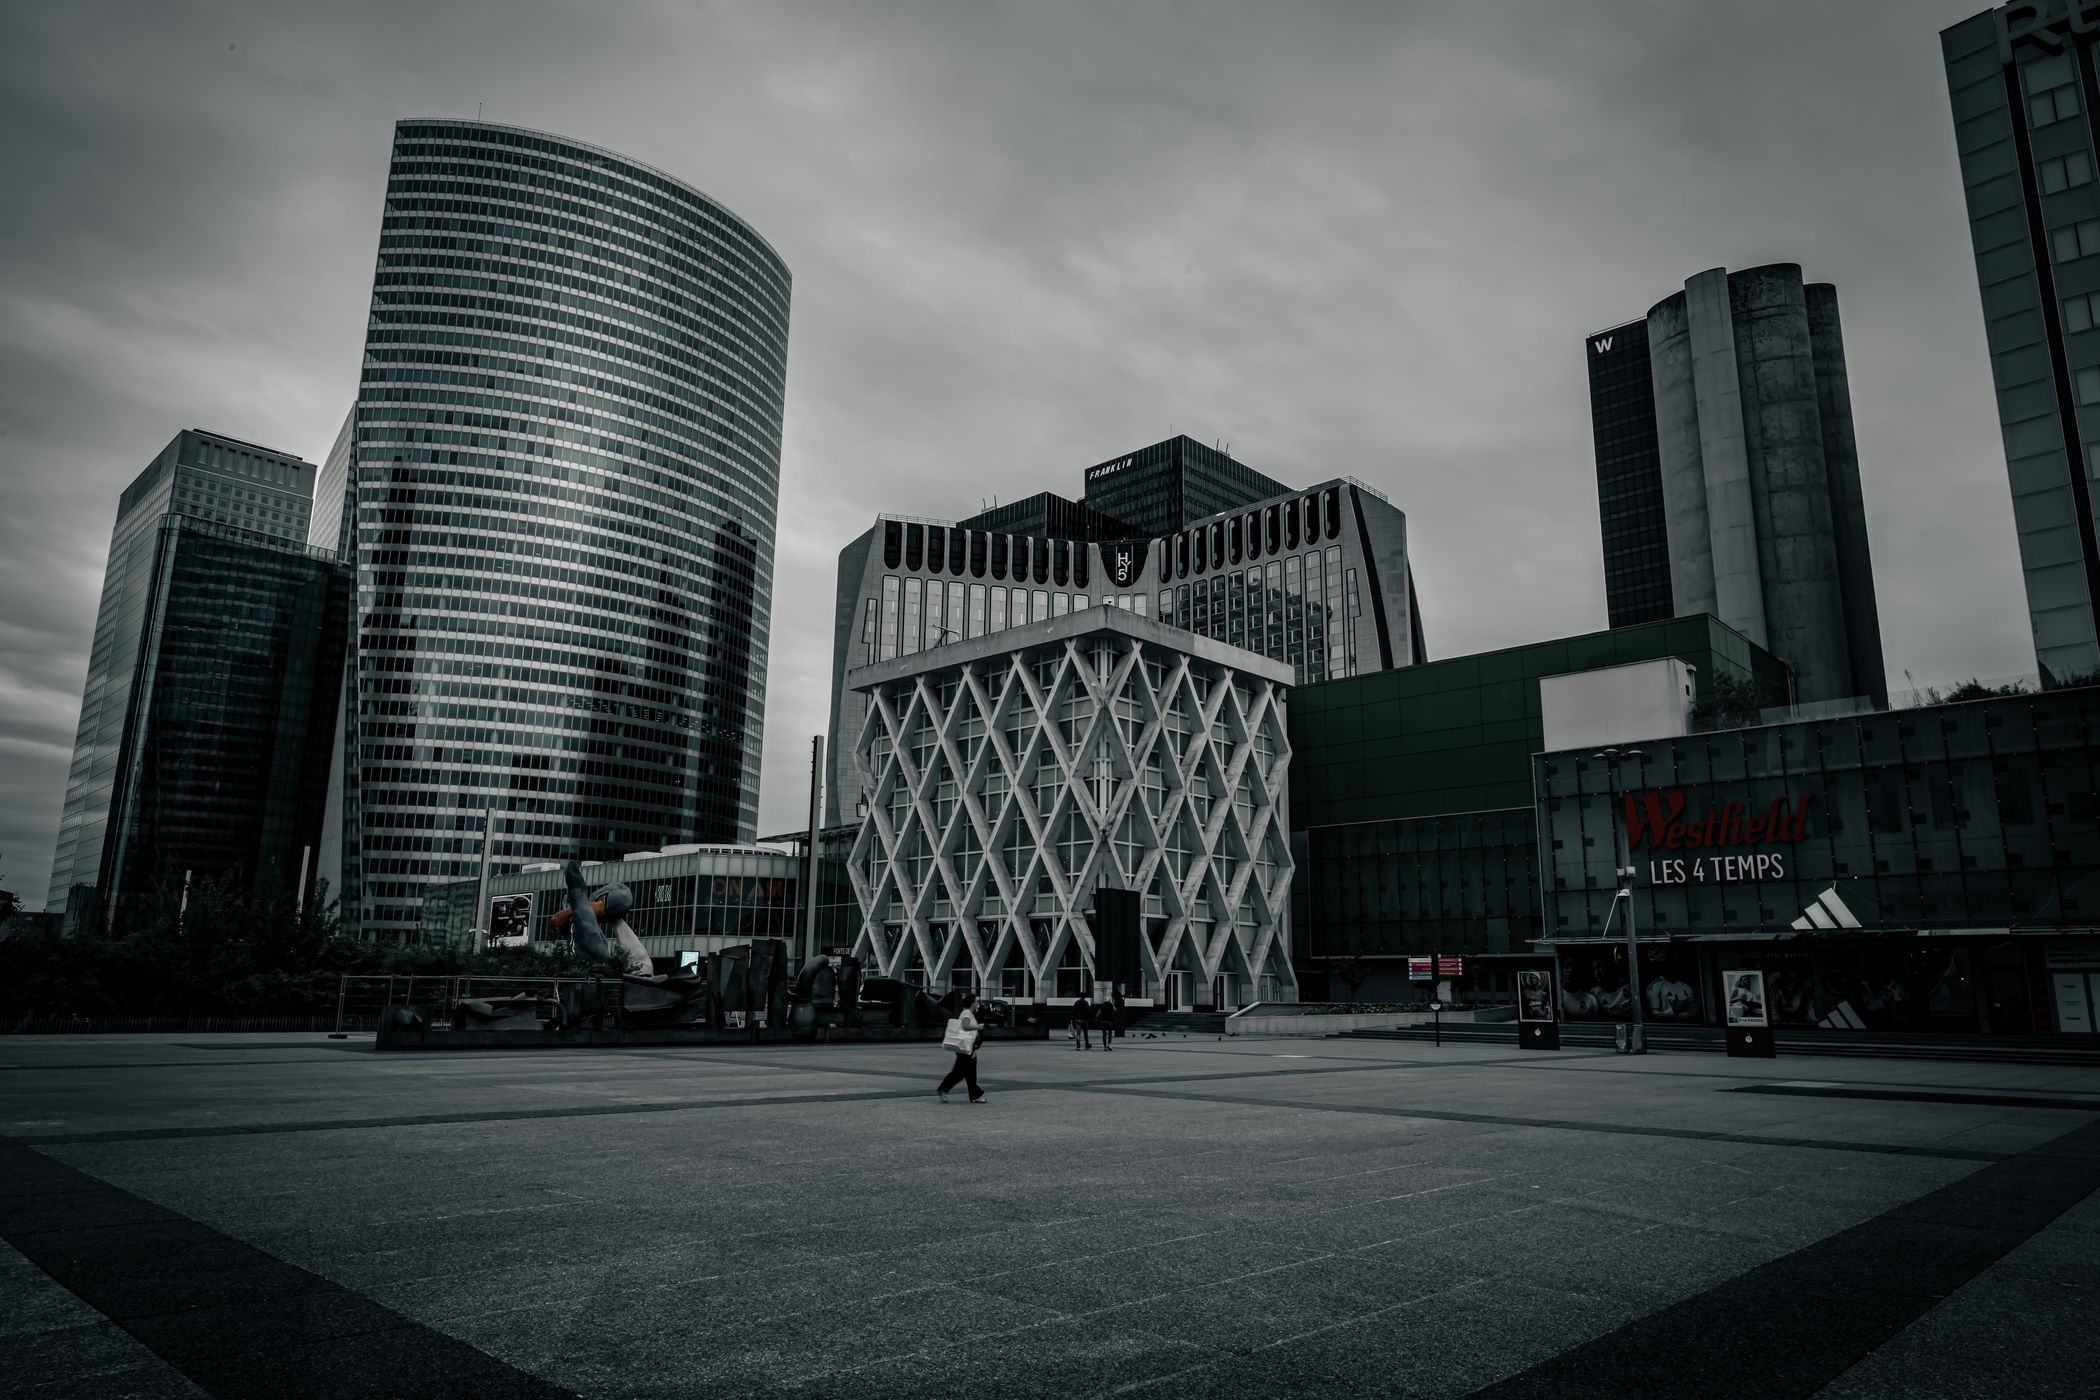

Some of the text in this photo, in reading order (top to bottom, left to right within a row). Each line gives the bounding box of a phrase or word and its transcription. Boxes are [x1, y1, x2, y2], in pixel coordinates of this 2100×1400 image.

[1595, 336, 1613, 354] W
[1089, 458, 1133, 480] FRANKLIN
[1619, 787, 1816, 852] Westfield
[1650, 853, 1785, 885] LES 4 TEMPS
